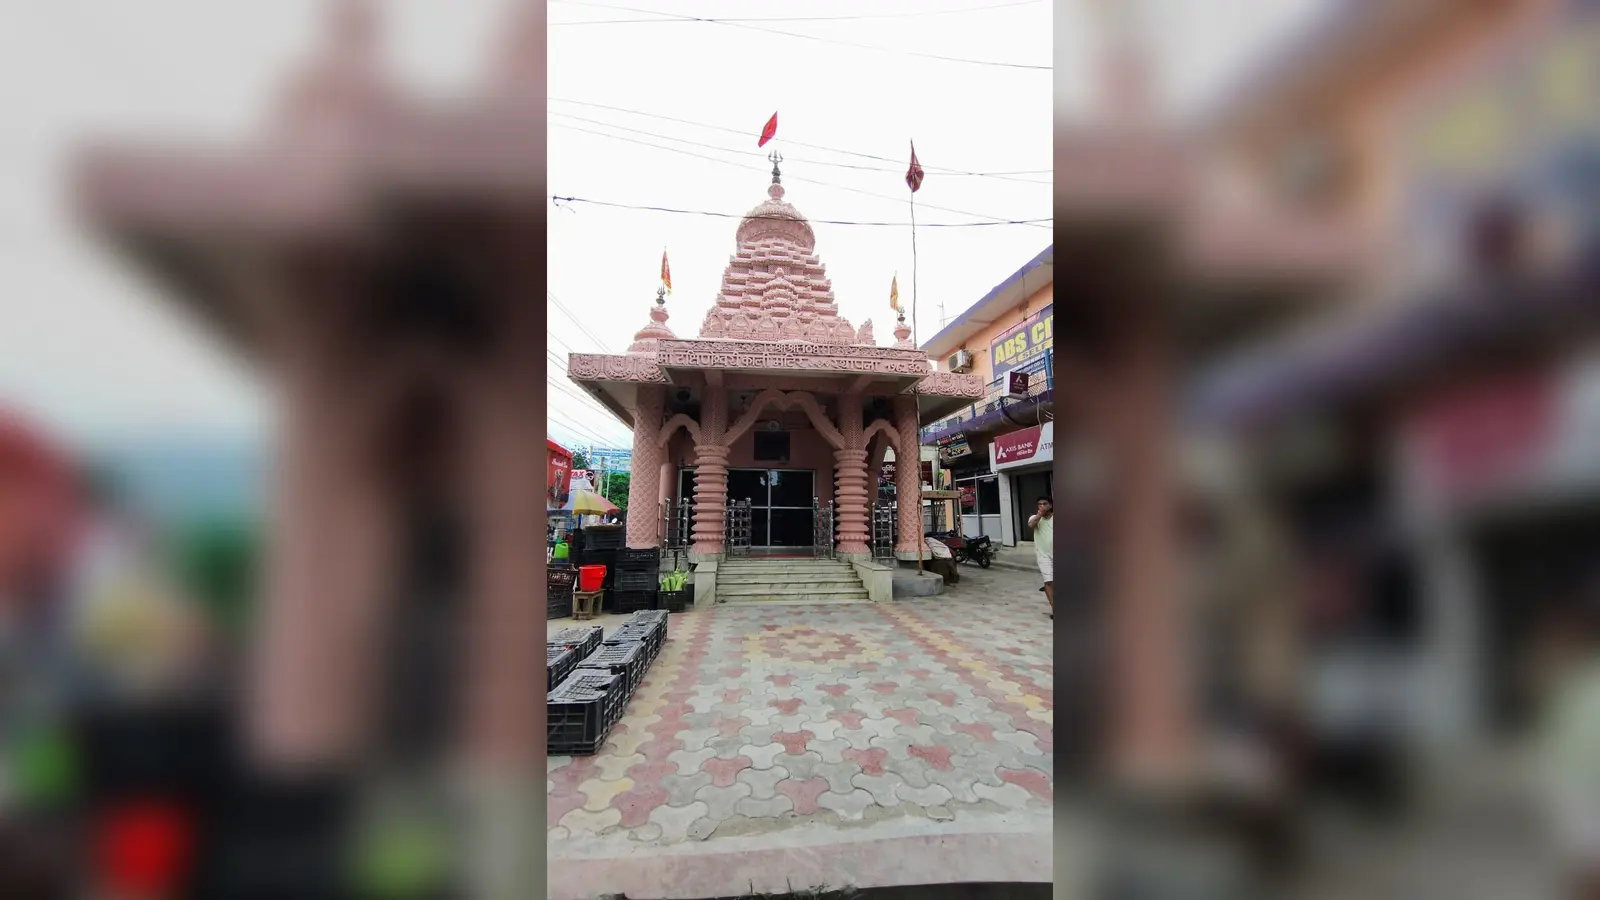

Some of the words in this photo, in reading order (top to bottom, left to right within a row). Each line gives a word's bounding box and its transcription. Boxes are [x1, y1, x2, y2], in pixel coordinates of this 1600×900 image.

[995, 332, 1027, 365] ABS
[1032, 315, 1053, 344] CI
[1005, 445, 1017, 453] AXIS
[1017, 441, 1033, 451] BANK
